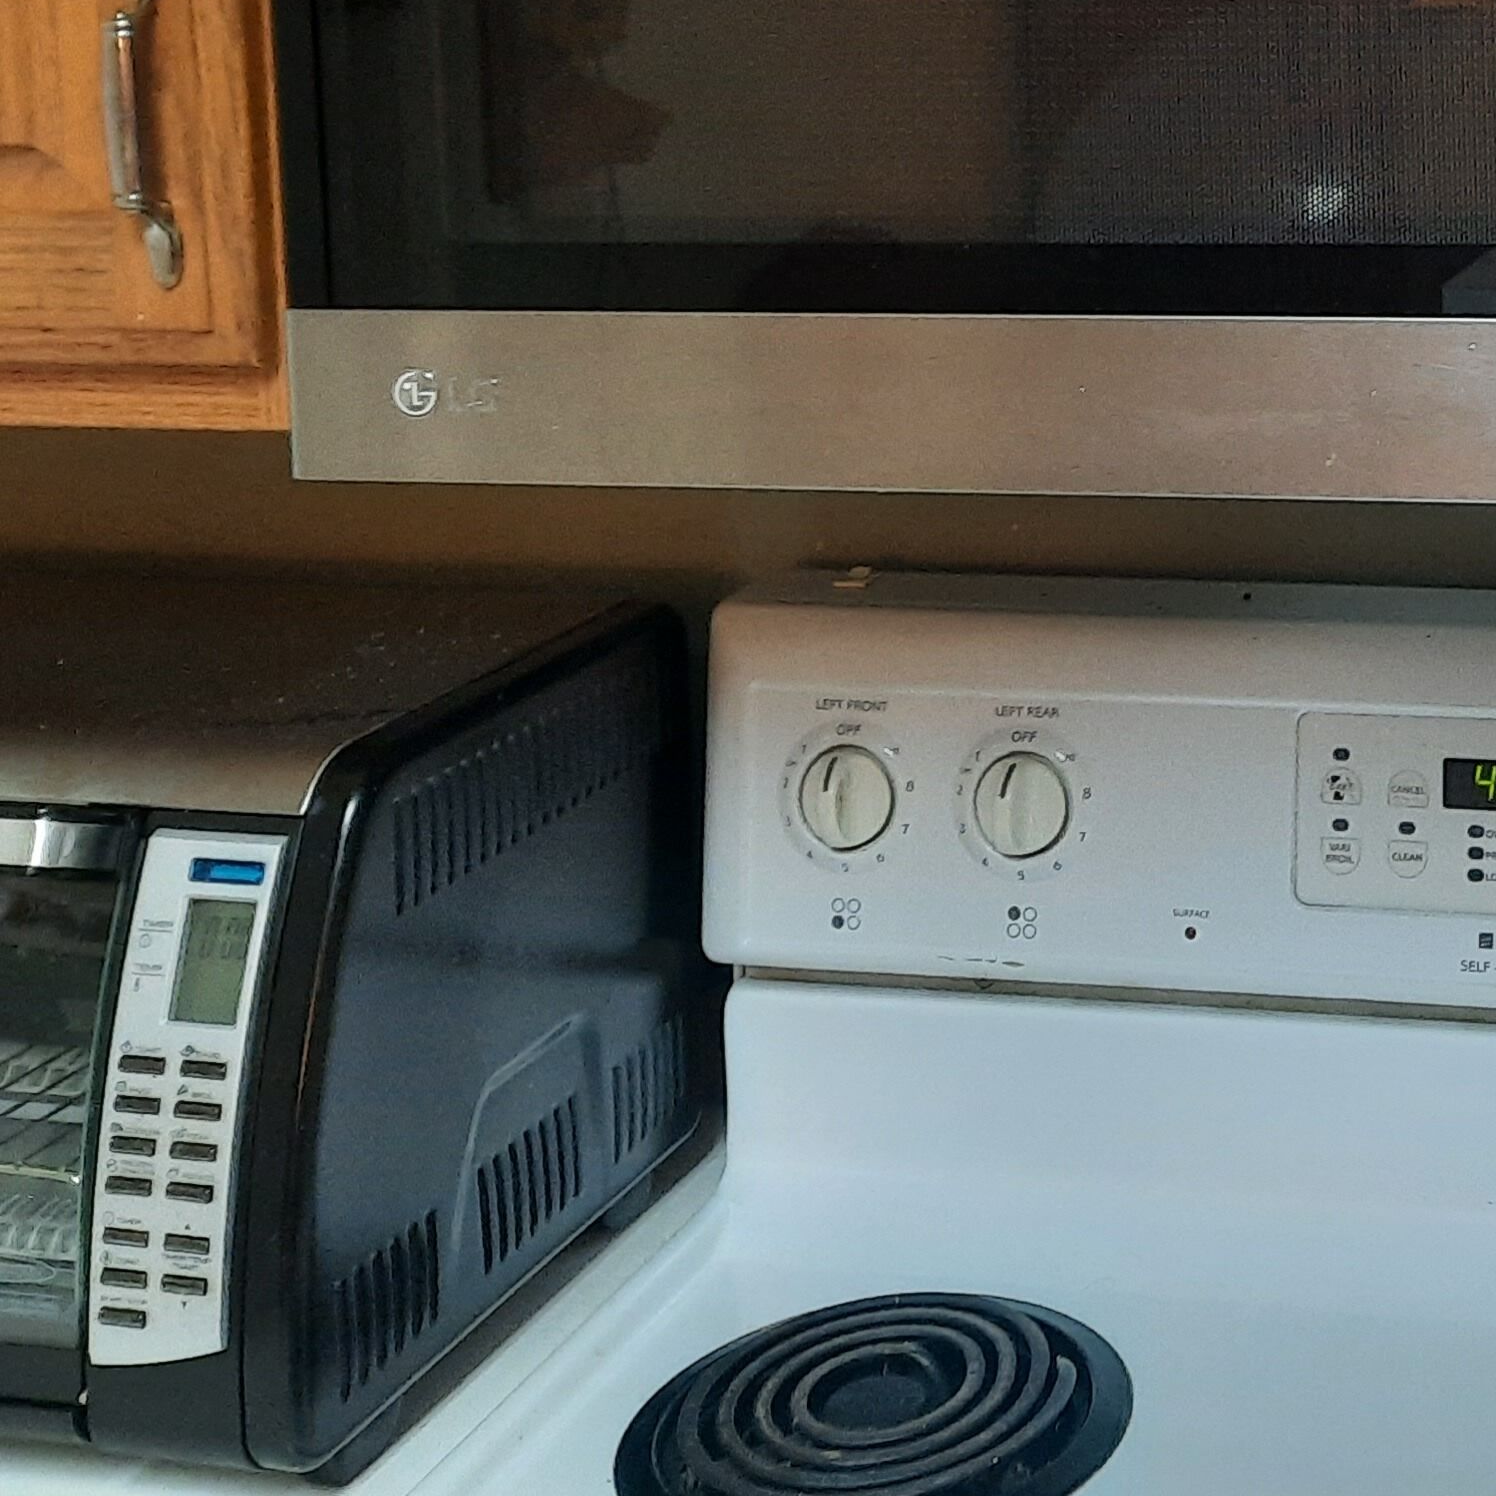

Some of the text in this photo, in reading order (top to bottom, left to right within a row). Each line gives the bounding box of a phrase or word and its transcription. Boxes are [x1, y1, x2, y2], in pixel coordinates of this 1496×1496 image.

[816, 698, 888, 712] LEFT FRONT
[995, 706, 1060, 719] LEFT REAR
[836, 723, 862, 736] OFF
[1011, 731, 1038, 743] OFF
[1082, 786, 1092, 800] 8
[901, 823, 910, 834] 7
[1079, 831, 1087, 842] 7
[1391, 852, 1423, 862] CLEAN
[1053, 860, 1062, 871] 6
[1460, 960, 1491, 973] SELF
